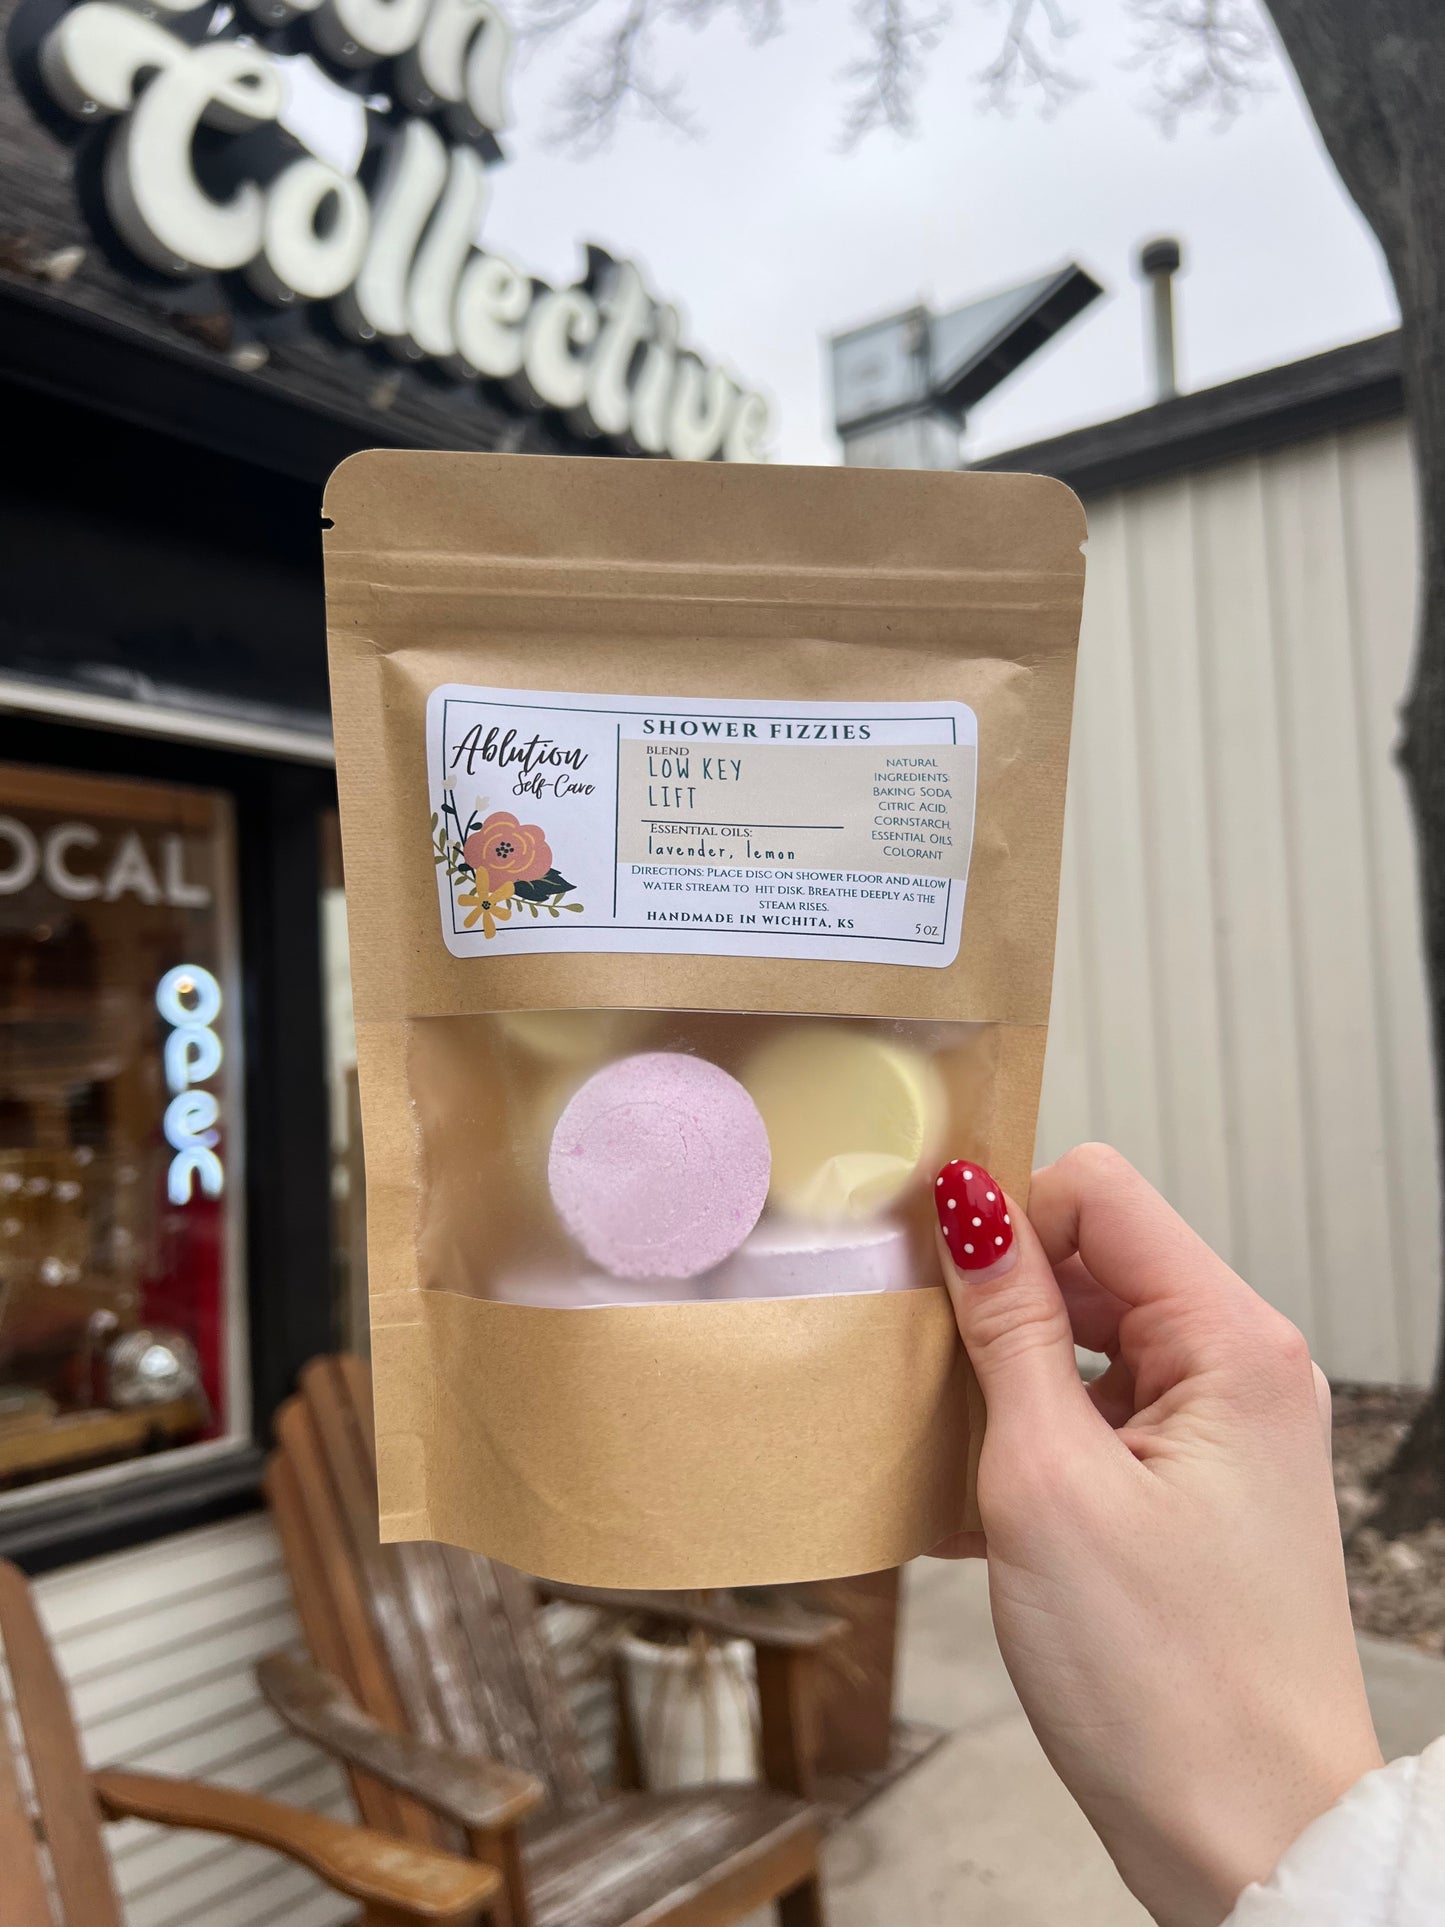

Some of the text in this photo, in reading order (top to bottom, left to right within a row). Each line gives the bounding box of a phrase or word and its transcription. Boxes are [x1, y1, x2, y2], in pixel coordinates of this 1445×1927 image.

[58, 3, 772, 463] Collective
[643, 719, 871, 740] SHOWER FIZZIES
[450, 723, 589, 776] Ablution
[646, 746, 690, 757] BLEND
[648, 756, 742, 781] LOW KEY
[886, 758, 939, 768] NATURAL
[512, 770, 596, 800] Self-Care
[873, 786, 916, 797] BAKING
[648, 785, 697, 809] LIFT
[878, 801, 916, 812] CITRIC
[650, 823, 753, 838] ESSENTIAL OILS:
[871, 830, 926, 844] ESSENTIAL
[648, 836, 795, 860] lavender, lemon
[883, 846, 944, 860] COLORANT
[631, 865, 947, 889] DIRECTIONS: PLACE DISC ON SHOWER FLOOR AND ALLOW
[643, 881, 683, 892] WATER
[686, 882, 730, 893] STREAM
[733, 884, 749, 893] TO
[755, 885, 775, 894] HIT
[808, 886, 858, 898] BREATHE
[860, 889, 901, 901] DEEPLY
[902, 893, 915, 902] AS
[917, 893, 936, 904] THE
[759, 900, 829, 912] STEAM RISES.
[647, 911, 854, 928] HANDMADE IN WICHITA, KS
[915, 923, 922, 935] 5
